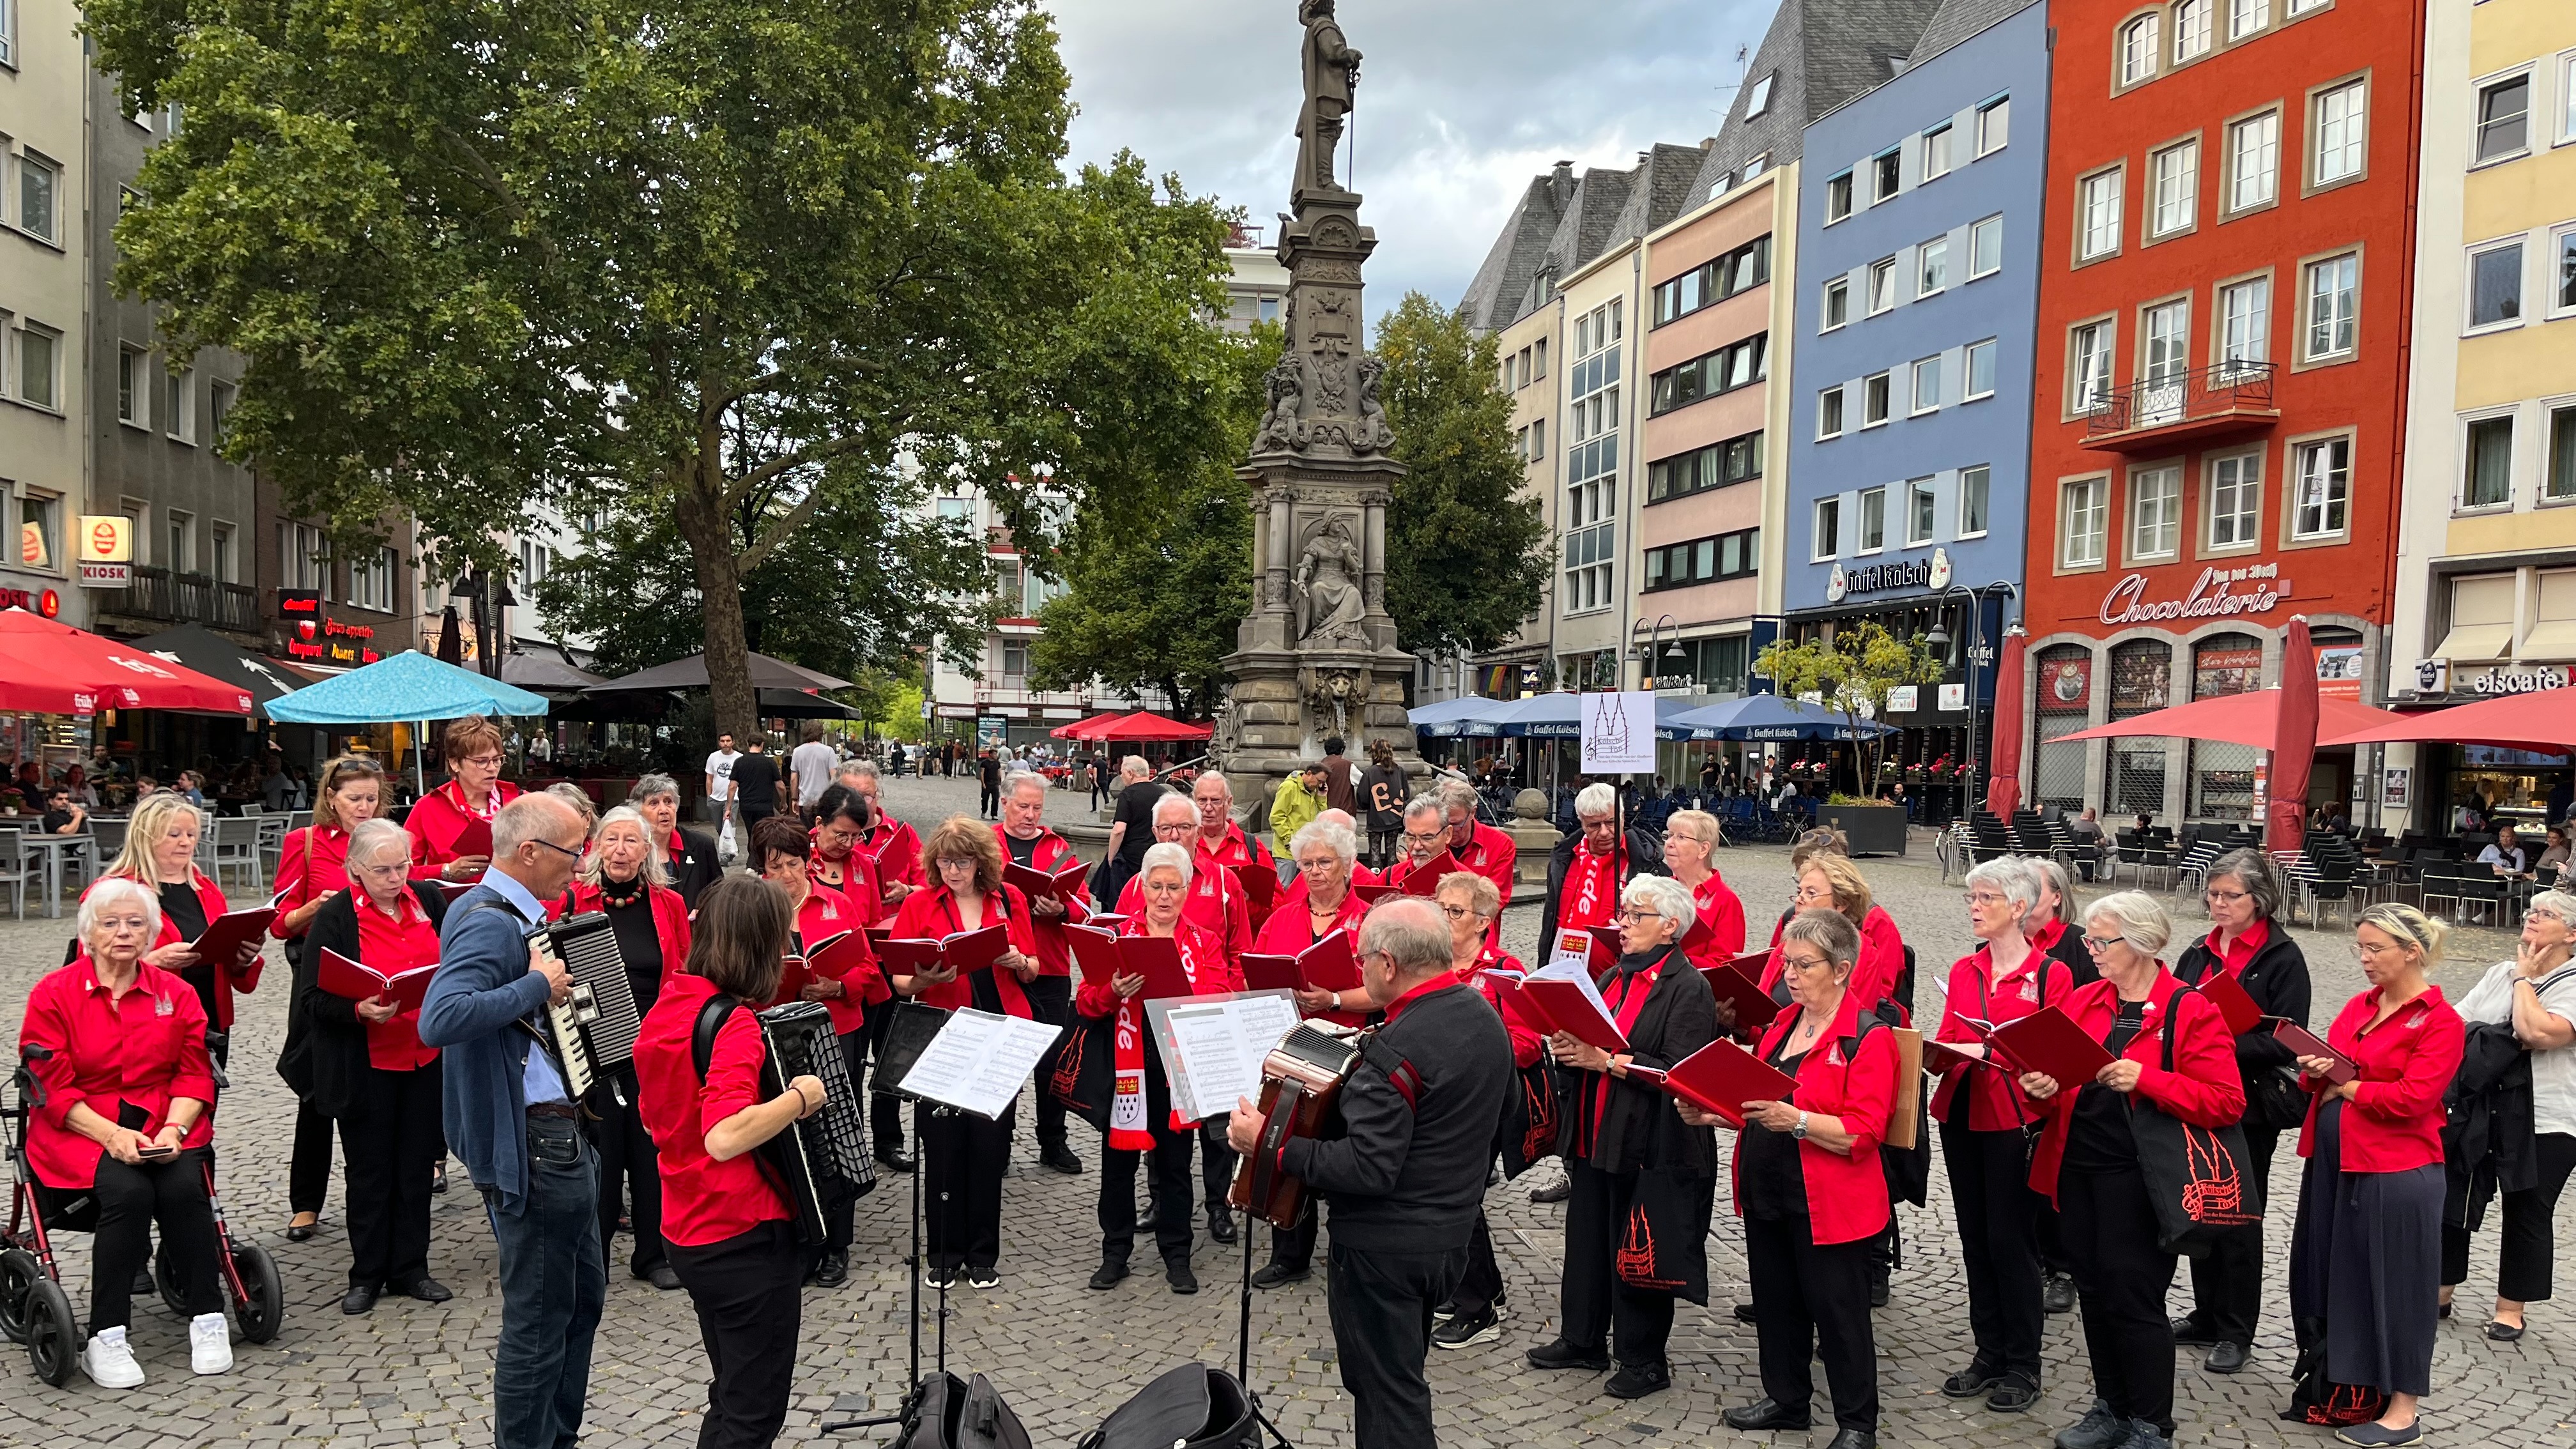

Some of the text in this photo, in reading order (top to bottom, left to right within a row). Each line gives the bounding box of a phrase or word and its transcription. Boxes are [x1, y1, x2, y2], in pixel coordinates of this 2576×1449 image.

[84, 567, 126, 579] KIOSK
[1846, 564, 1882, 592] Gaffel
[2231, 569, 2246, 581] von
[2099, 567, 2278, 624] Chocolaterie
[1534, 724, 1555, 735] Gaffel
[1754, 728, 1774, 738] Gaffel
[2200, 1182, 2235, 1195] Kölsche
